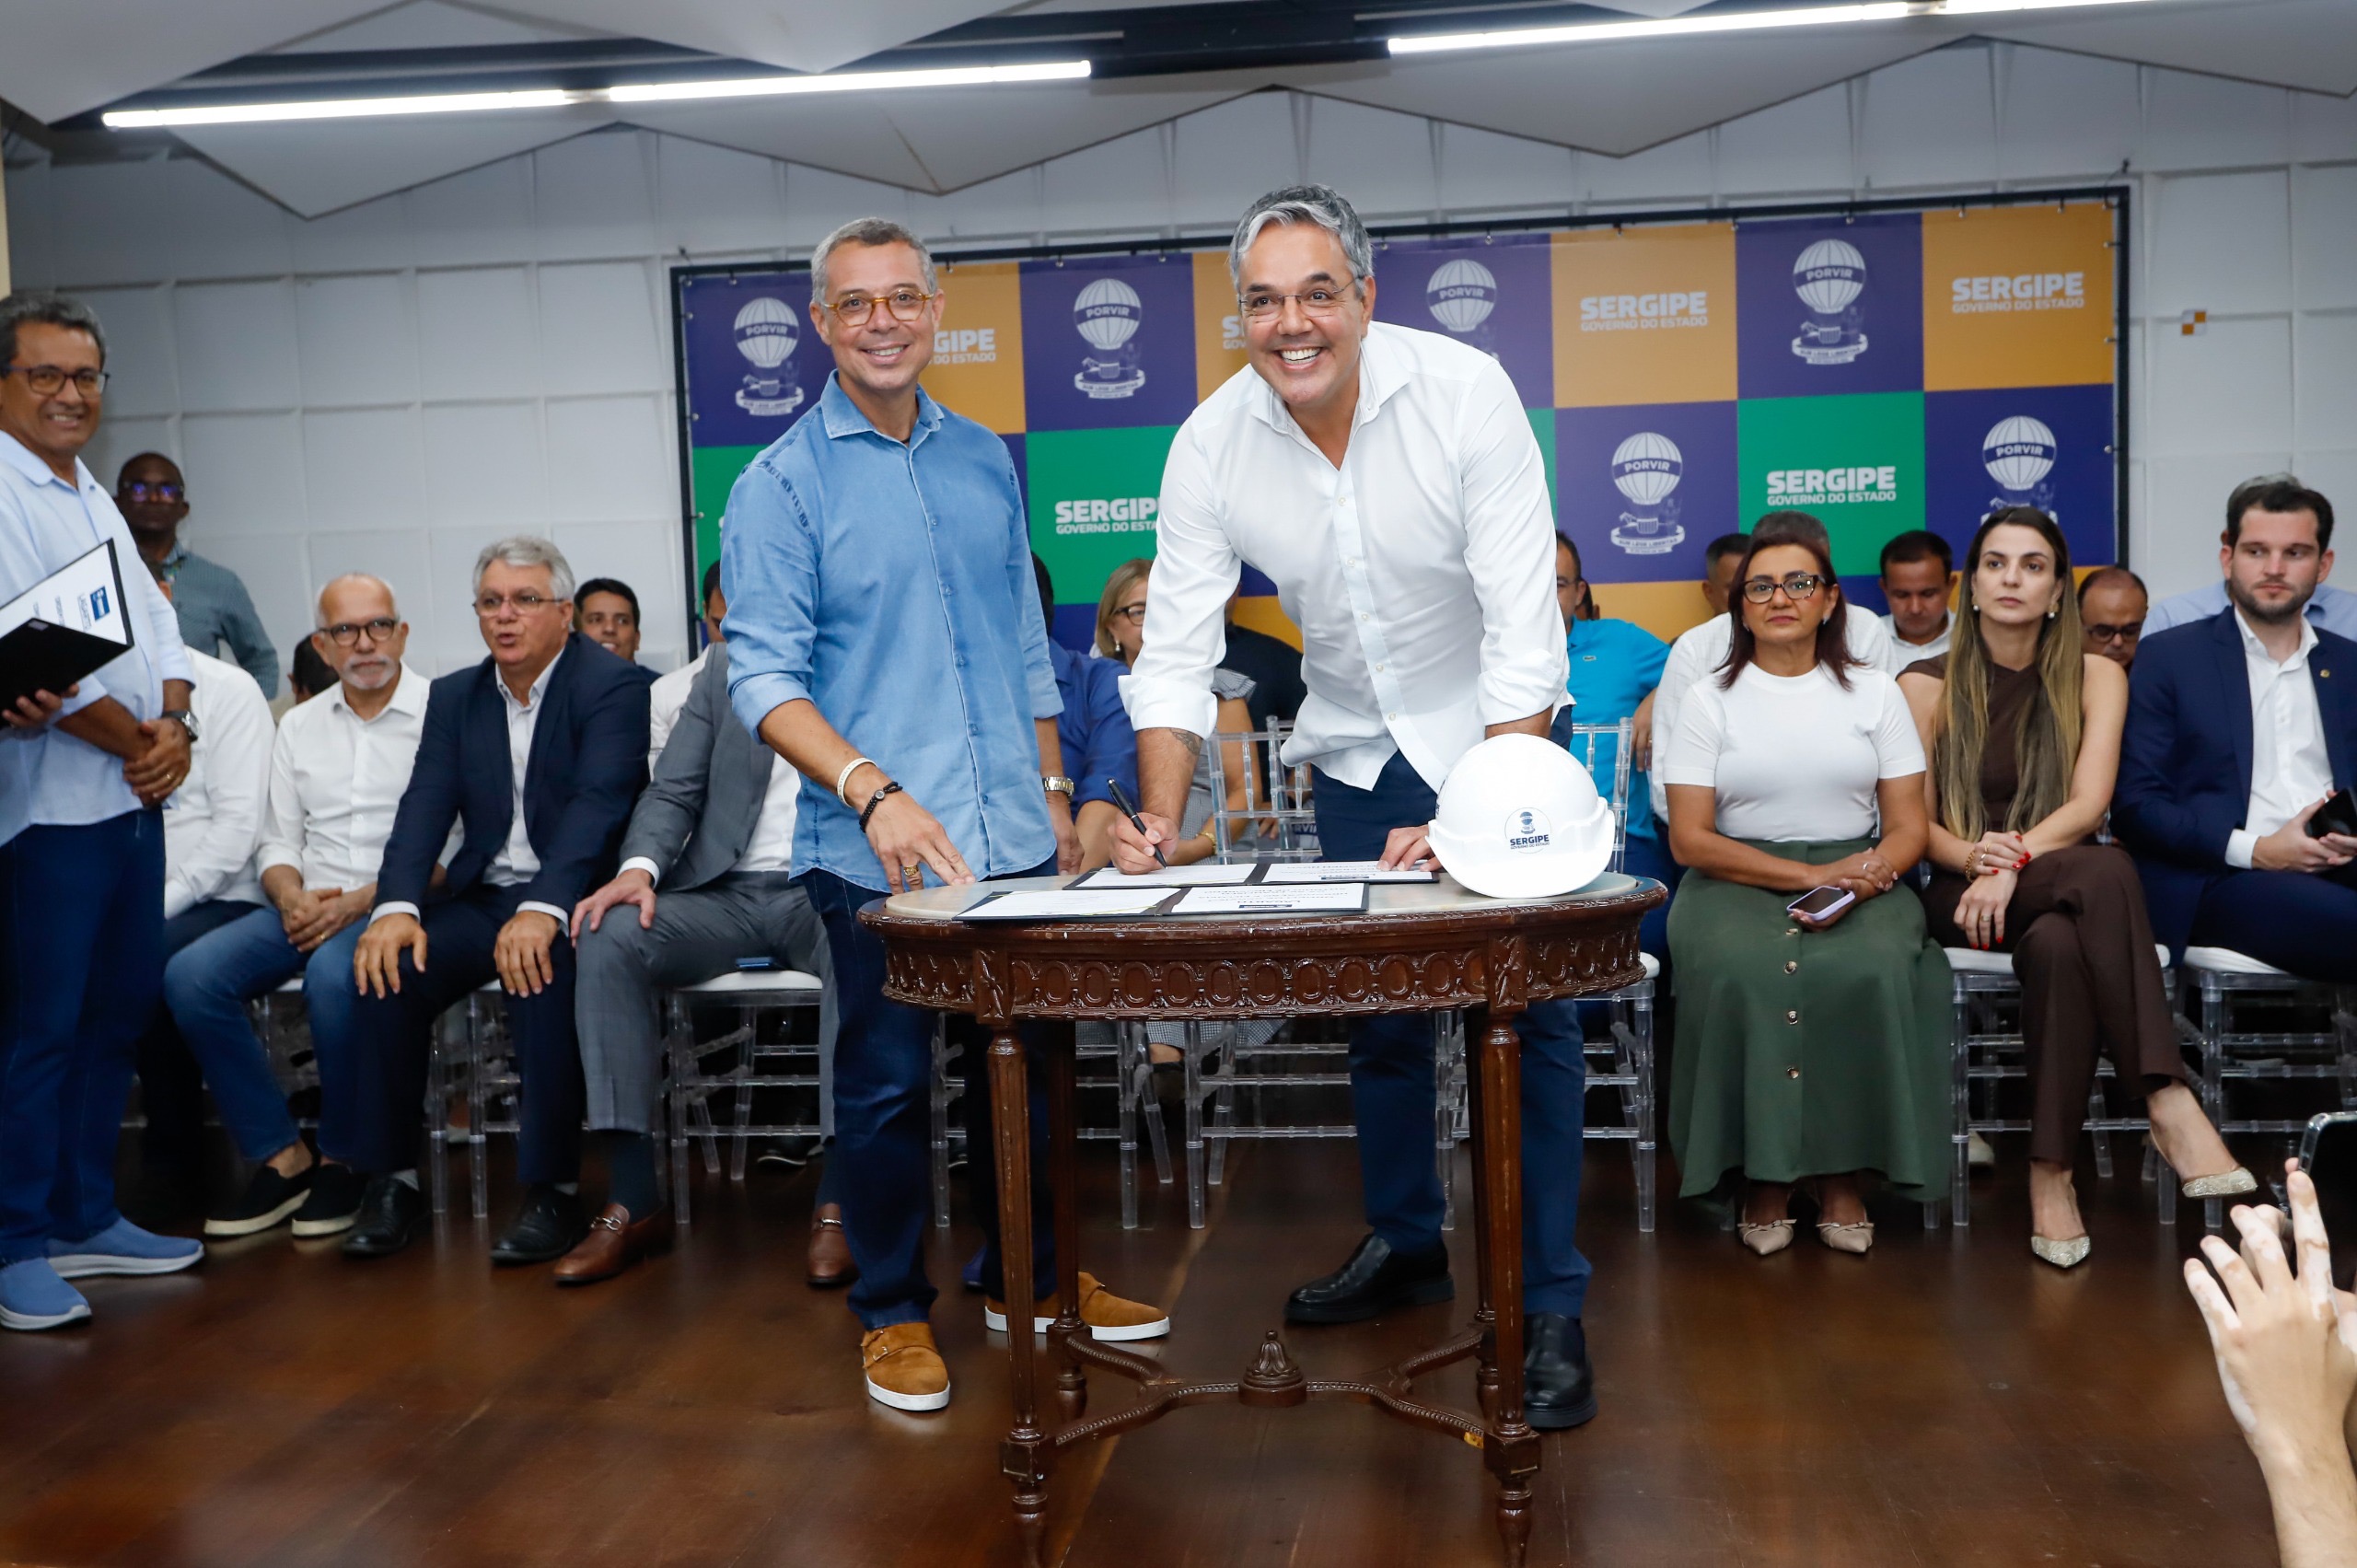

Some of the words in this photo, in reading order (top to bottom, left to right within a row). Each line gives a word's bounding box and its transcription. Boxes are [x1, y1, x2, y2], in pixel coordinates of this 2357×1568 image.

[1806, 267, 1853, 281] PORVIR
[1439, 286, 1485, 299] PORVIR
[1952, 272, 2084, 302] SERGIPE
[1580, 291, 1707, 320] SERGIPE
[1953, 299, 2012, 313] GOVERNO
[2014, 298, 2033, 310] DO
[2035, 296, 2084, 309] ESTADO
[1086, 306, 1130, 318] PORVIR
[746, 323, 787, 336] PORVIR
[1581, 319, 1638, 331] GOVERNO
[1640, 318, 1657, 329] DO
[1660, 315, 1708, 328] ESTADO
[934, 328, 995, 353] GIPE
[934, 354, 950, 365] DO
[952, 352, 996, 364] ESTADO
[1996, 444, 2043, 458] PORVIR
[1624, 460, 1670, 472] PORVIR
[1767, 466, 1896, 494] SERGIPE
[1767, 493, 1826, 505] GOVERNO
[1828, 492, 1846, 503] DO
[1848, 490, 1897, 503] ESTADO
[1055, 497, 1160, 524] SERGIP
[1055, 522, 1110, 534] GOVERNO
[1111, 521, 1129, 532] DO
[1510, 834, 1550, 846] SERGIPE
